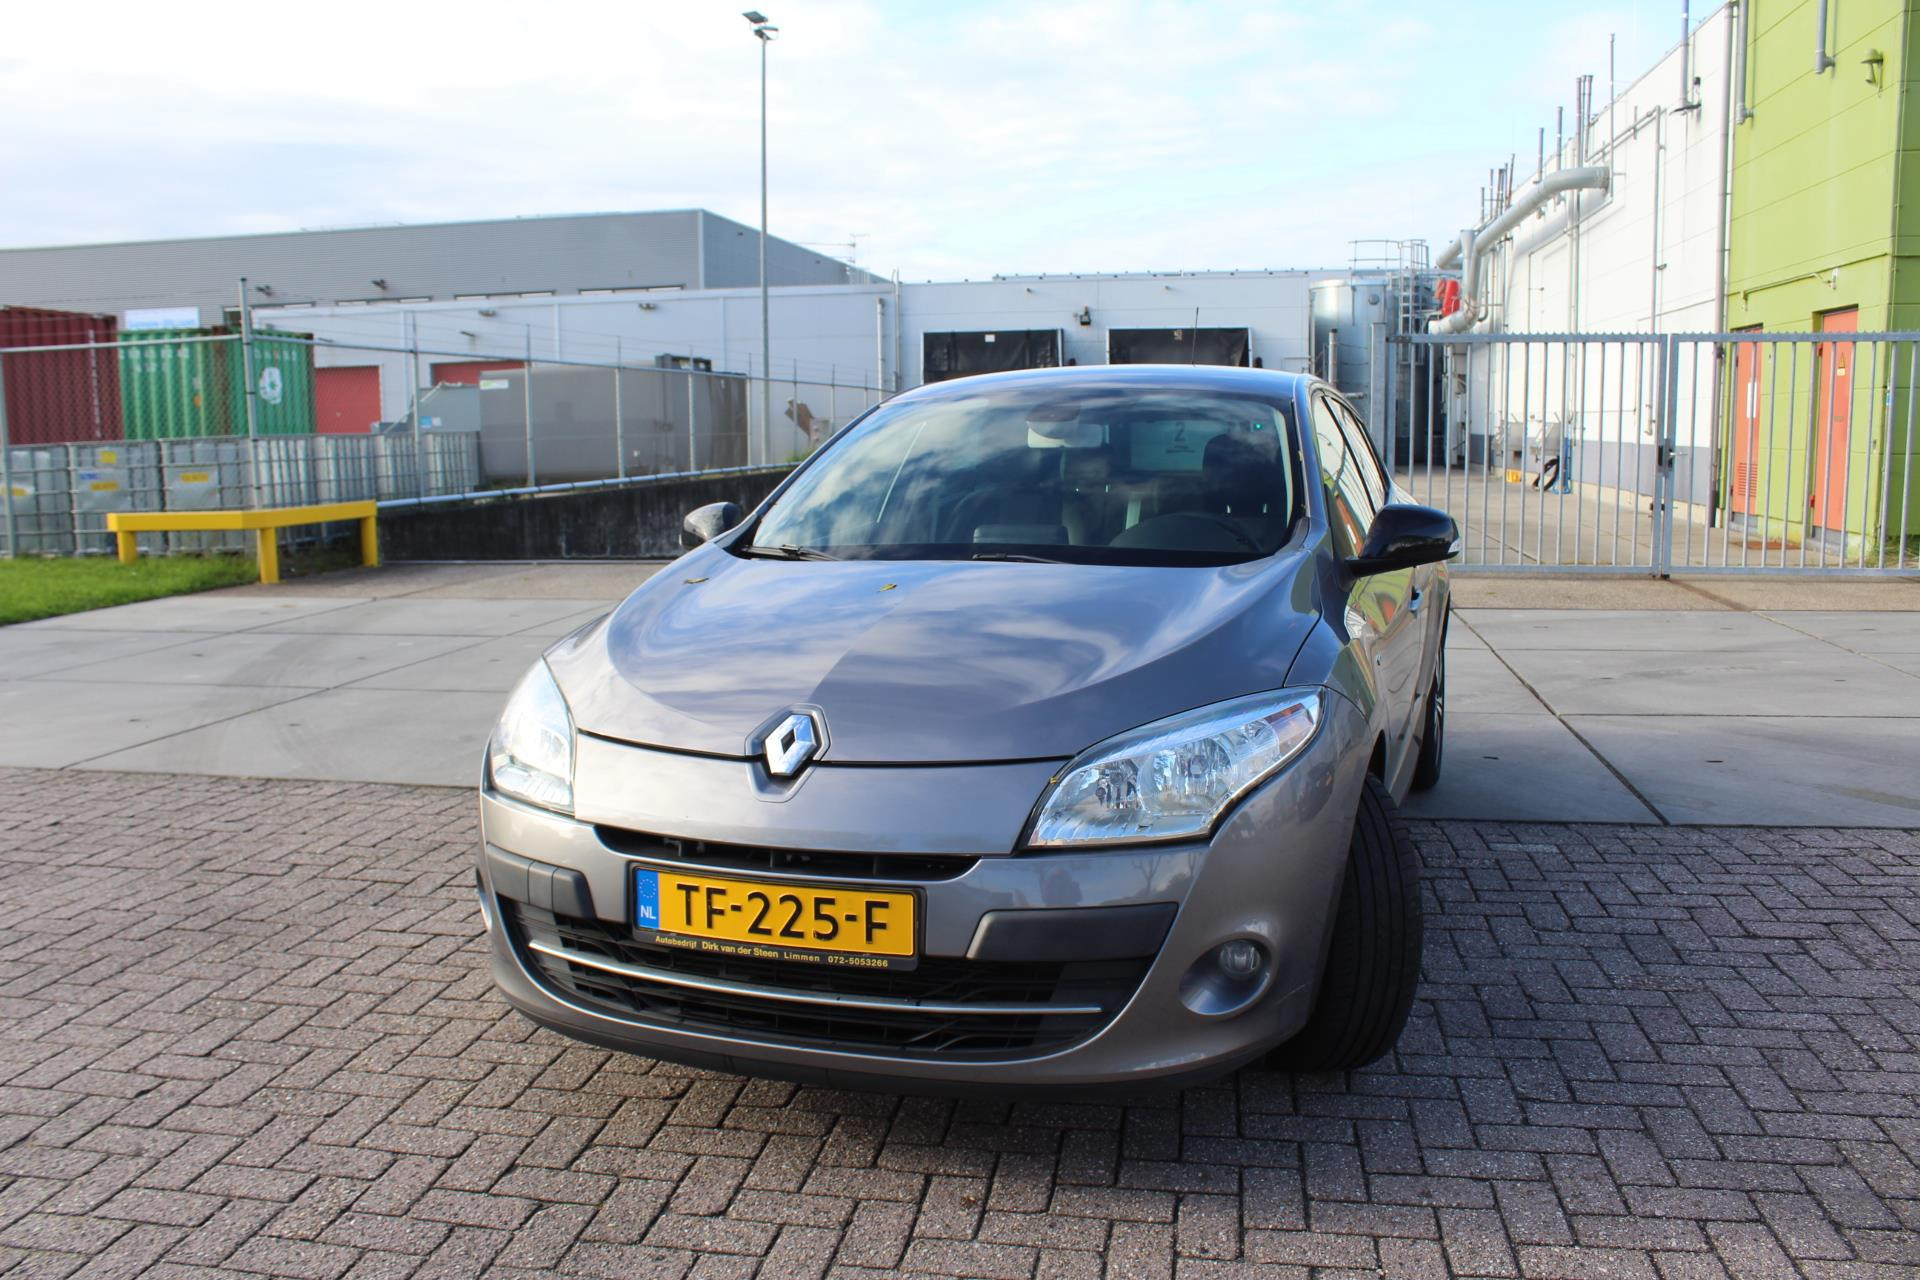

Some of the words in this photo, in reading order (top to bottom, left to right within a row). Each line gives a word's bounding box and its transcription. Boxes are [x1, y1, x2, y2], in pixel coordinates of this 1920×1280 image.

[640, 904, 657, 920] NL
[676, 882, 890, 944] TF-225-F
[655, 935, 697, 949] Autobedrijf
[701, 940, 719, 951] Dirk
[720, 945, 736, 953] van
[737, 946, 752, 955] der
[753, 947, 779, 958] Steen
[784, 951, 820, 962] Limmen
[827, 955, 889, 968] 072-5053266
